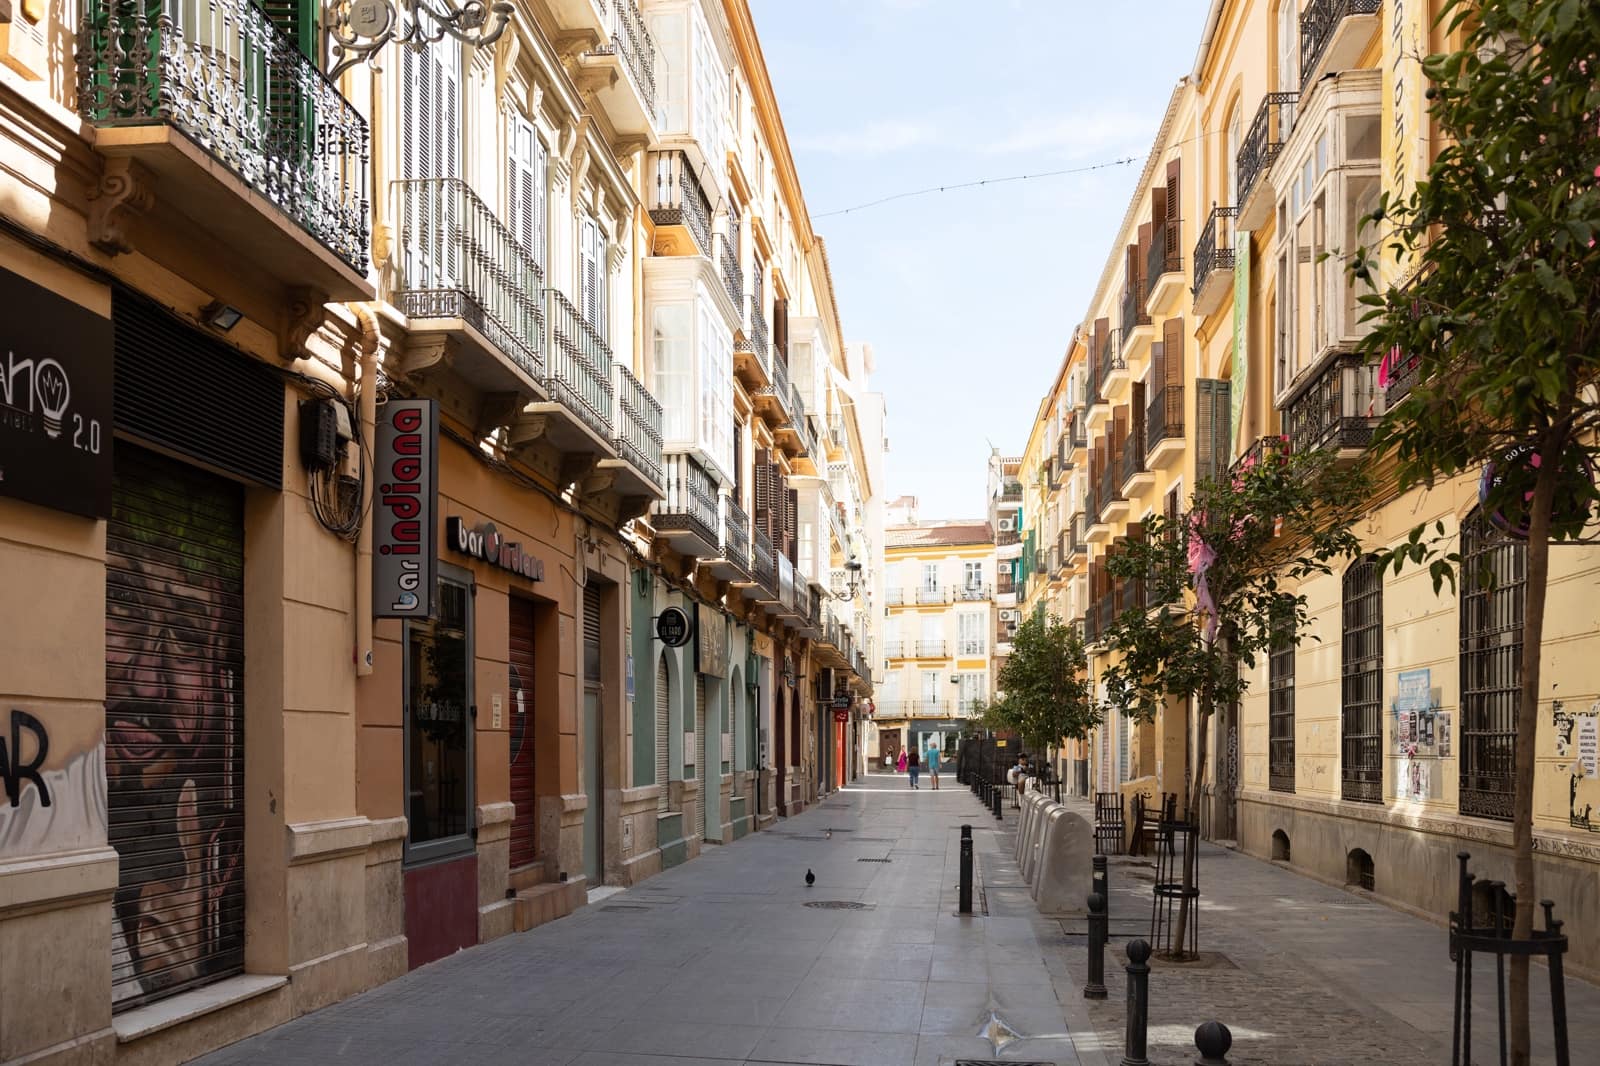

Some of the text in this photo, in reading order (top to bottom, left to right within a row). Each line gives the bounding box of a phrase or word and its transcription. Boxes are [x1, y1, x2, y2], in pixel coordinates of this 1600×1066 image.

[73, 413, 100, 455] 2.0
[380, 408, 422, 612] bar indiana
[458, 517, 544, 582] bar indiana
[668, 626, 682, 636] FARO
